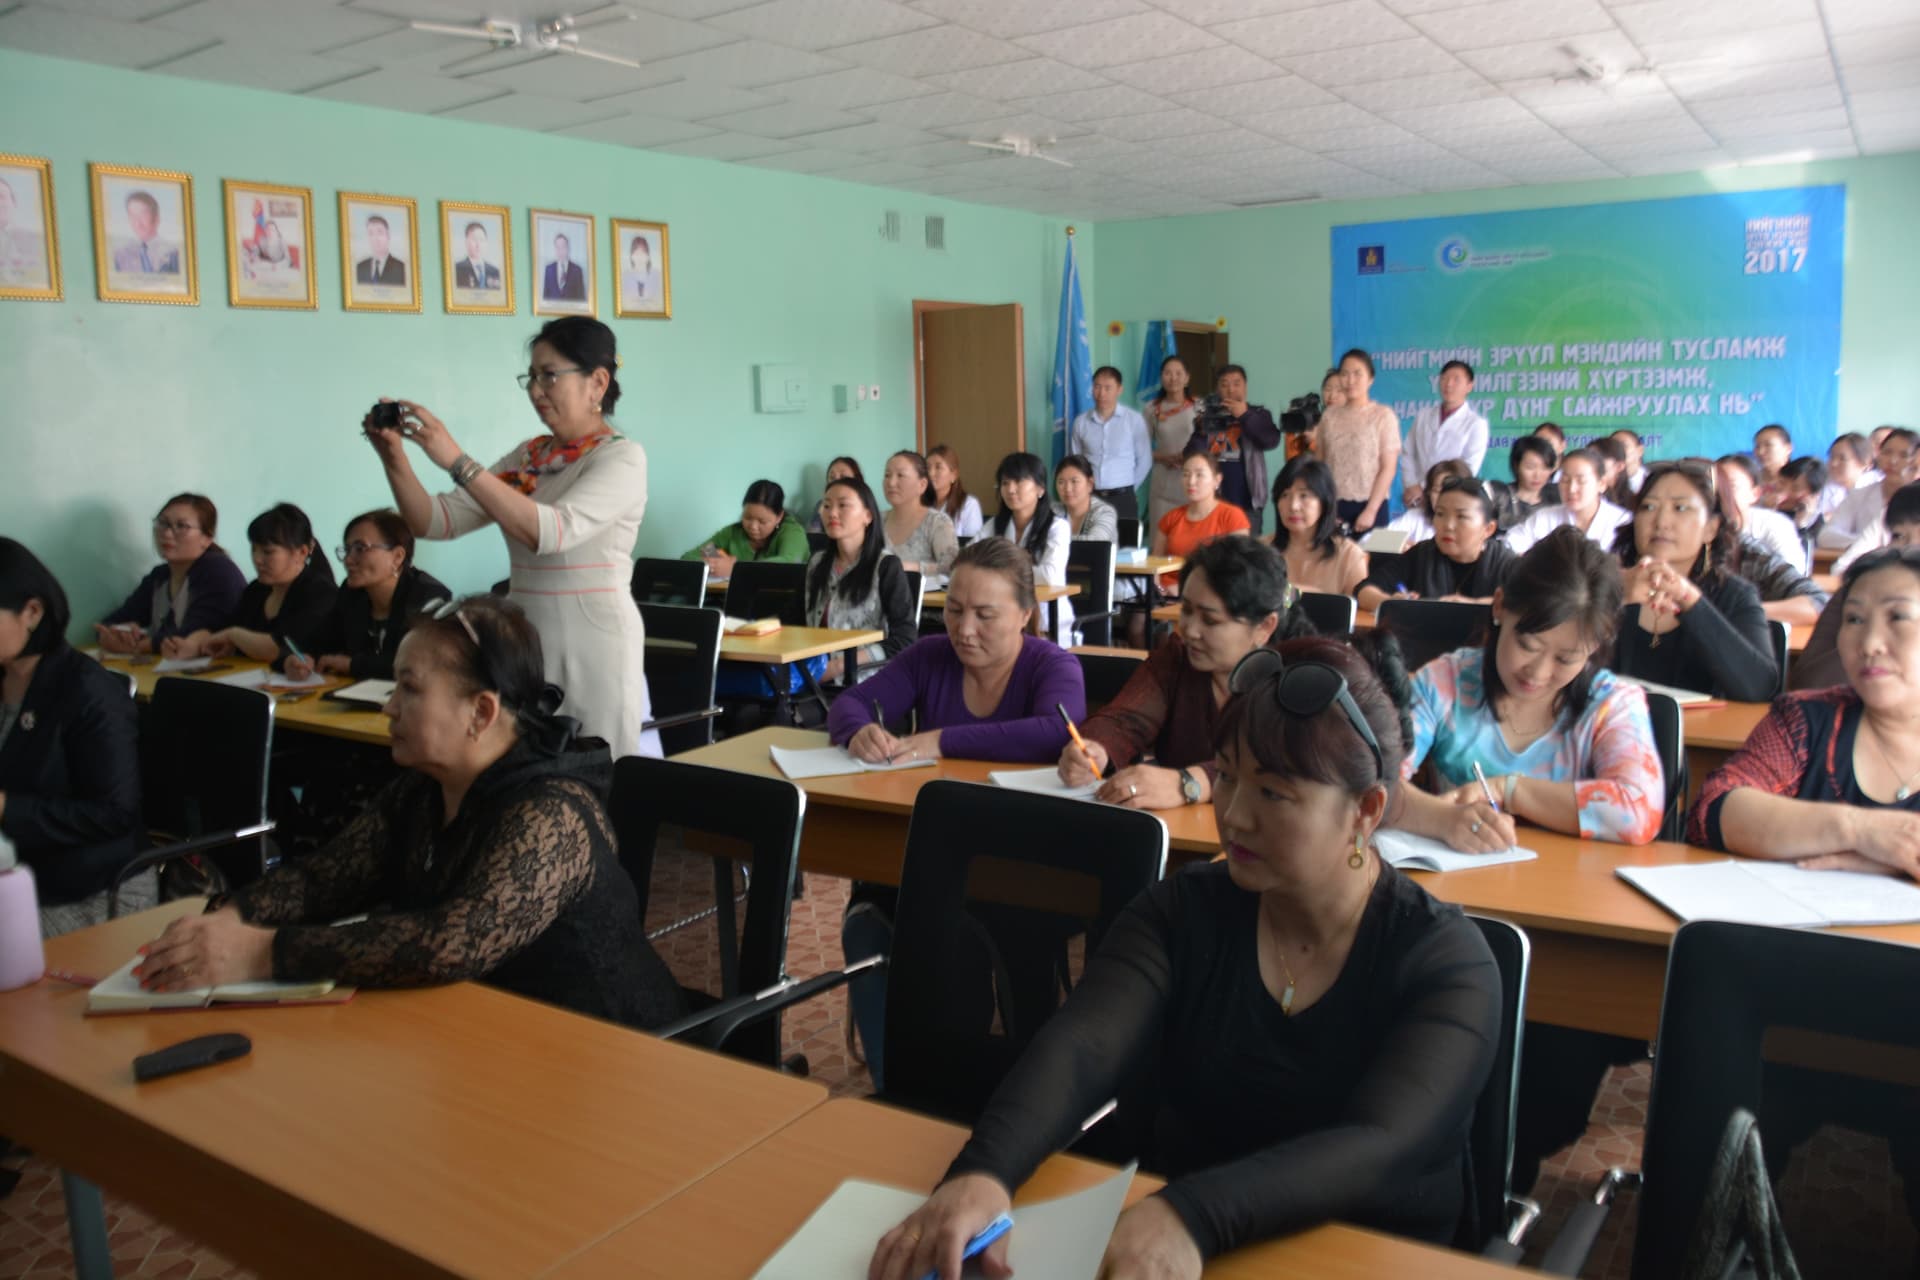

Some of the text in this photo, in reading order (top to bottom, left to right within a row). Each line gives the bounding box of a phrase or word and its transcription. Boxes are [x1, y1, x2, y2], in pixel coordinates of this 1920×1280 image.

[1744, 248, 1808, 274] 2017
[1564, 340, 1661, 364] МЭНДИЙН
[1672, 337, 1786, 360] ТУСЛАМЖ
[1562, 392, 1711, 417] САЙЖРУУЛАХ
